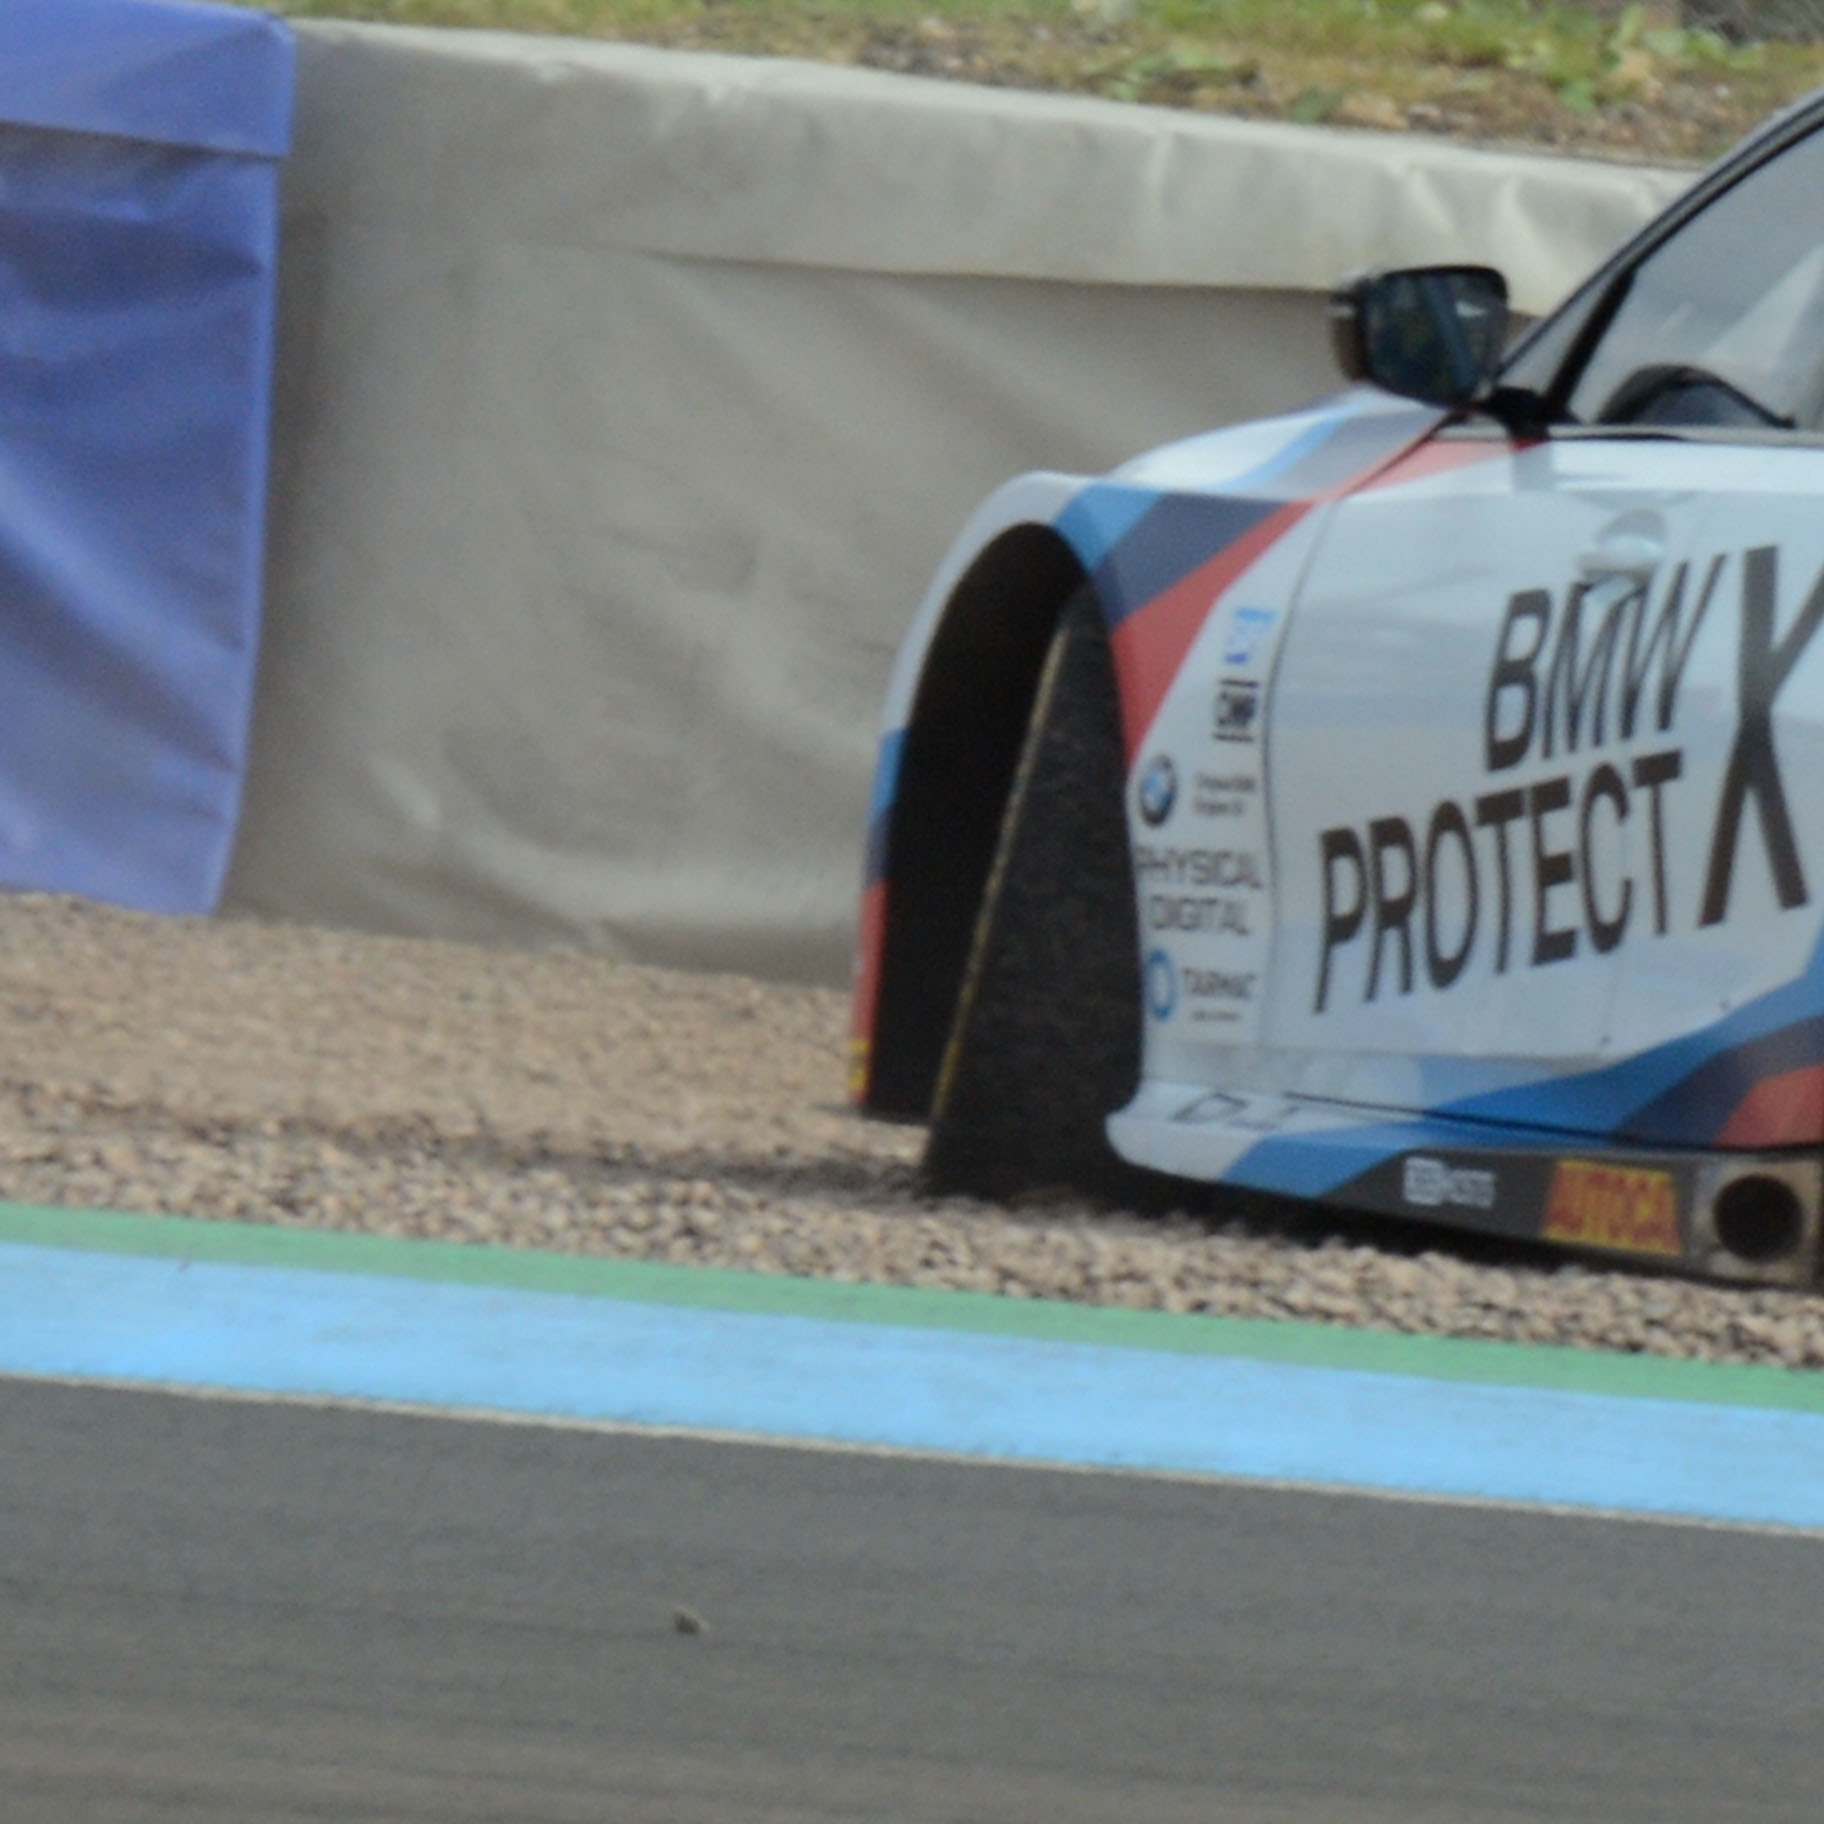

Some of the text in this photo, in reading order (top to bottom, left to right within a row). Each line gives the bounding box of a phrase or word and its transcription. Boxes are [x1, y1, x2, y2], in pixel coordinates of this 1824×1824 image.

[1484, 553, 1727, 772] BMW
[1133, 844, 1264, 890] PHYSICAL
[1150, 894, 1250, 937] DIGITAL
[1313, 749, 1684, 1015] PROTECT
